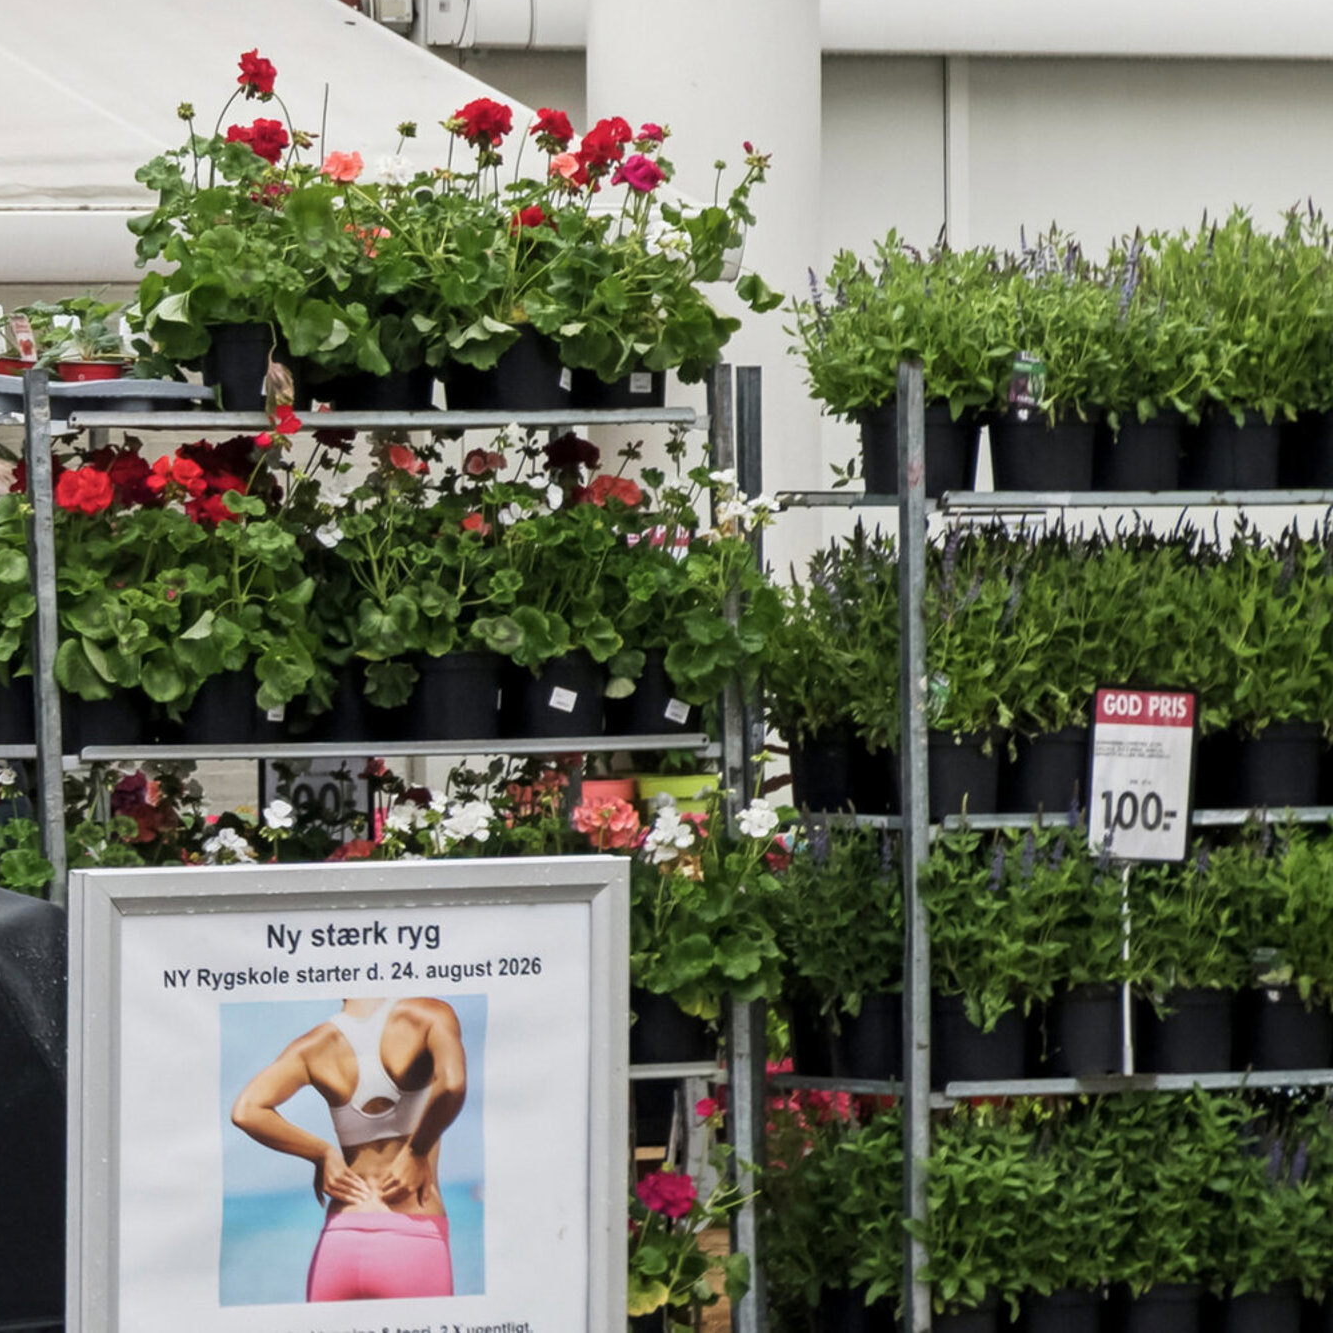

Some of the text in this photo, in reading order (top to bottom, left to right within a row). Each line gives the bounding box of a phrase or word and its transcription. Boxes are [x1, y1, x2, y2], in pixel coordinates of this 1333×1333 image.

[1103, 693, 1187, 718] GOD PRIS
[267, 921, 441, 954] Ny stærk ryg
[163, 957, 542, 991] NY Rygskole starter d. 24. august 2026
